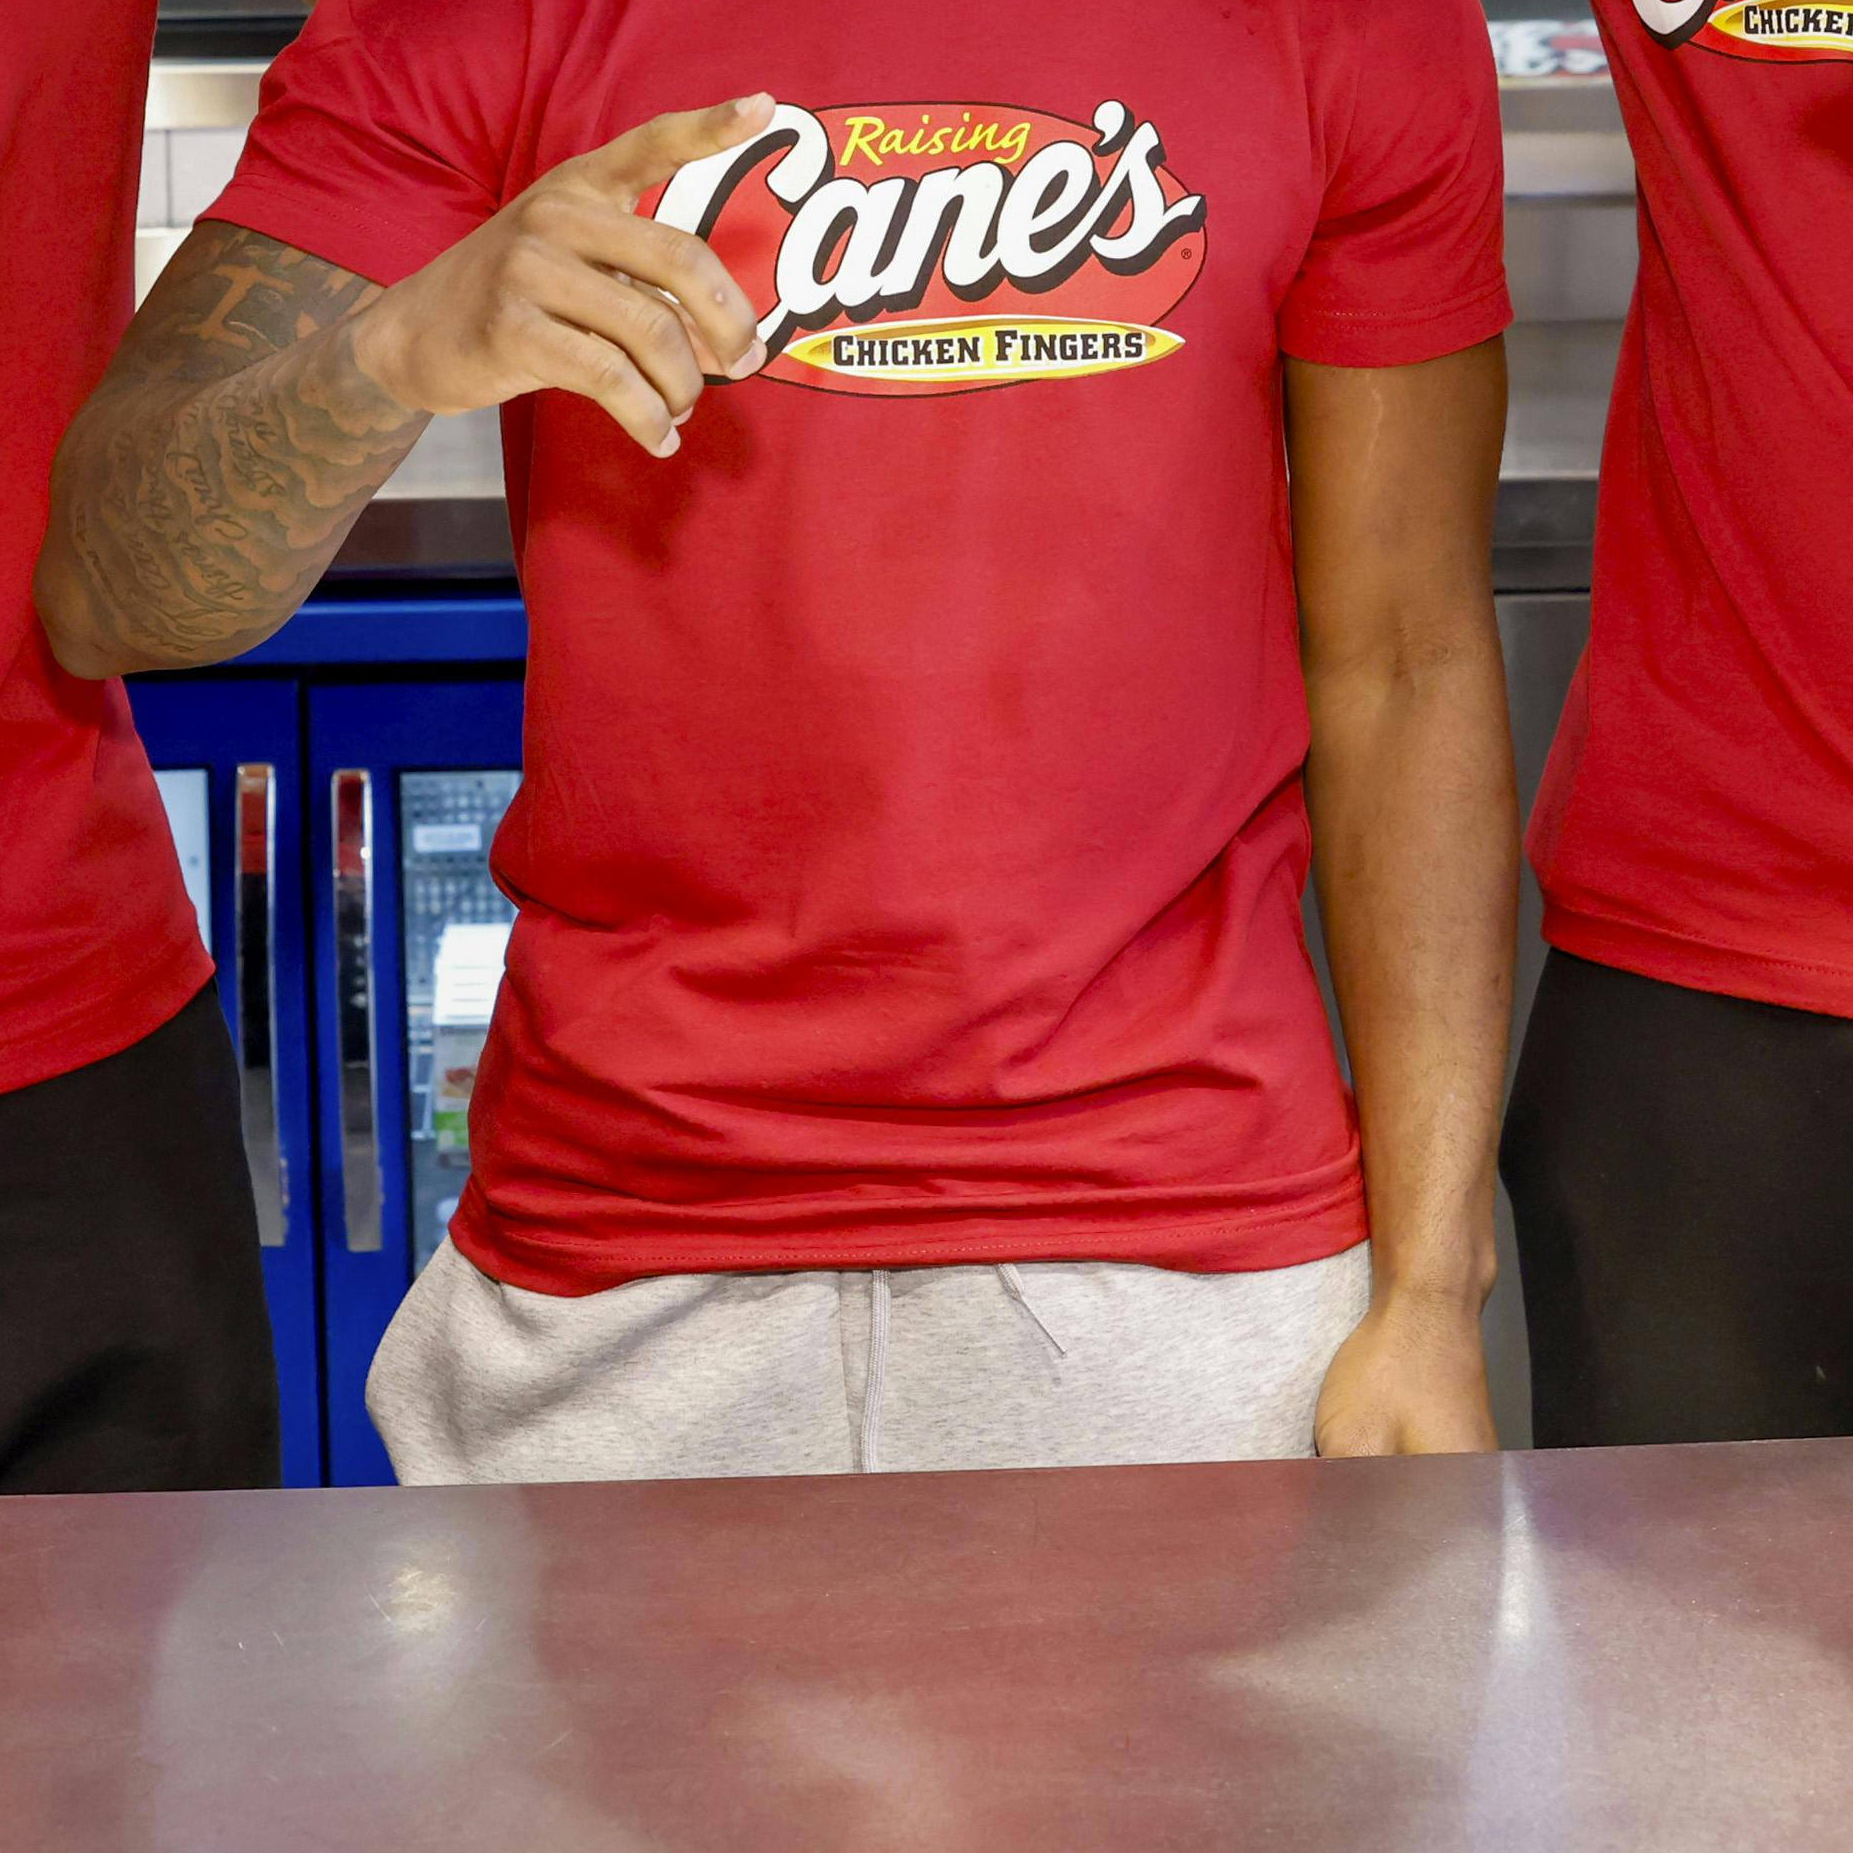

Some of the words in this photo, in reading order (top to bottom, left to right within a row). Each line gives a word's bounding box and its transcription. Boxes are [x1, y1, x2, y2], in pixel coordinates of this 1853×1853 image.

[839, 111, 1032, 167] Raising
[651, 98, 1207, 385] Cane's
[833, 332, 980, 367] CHICKEN
[994, 328, 1144, 361] FINGERS
